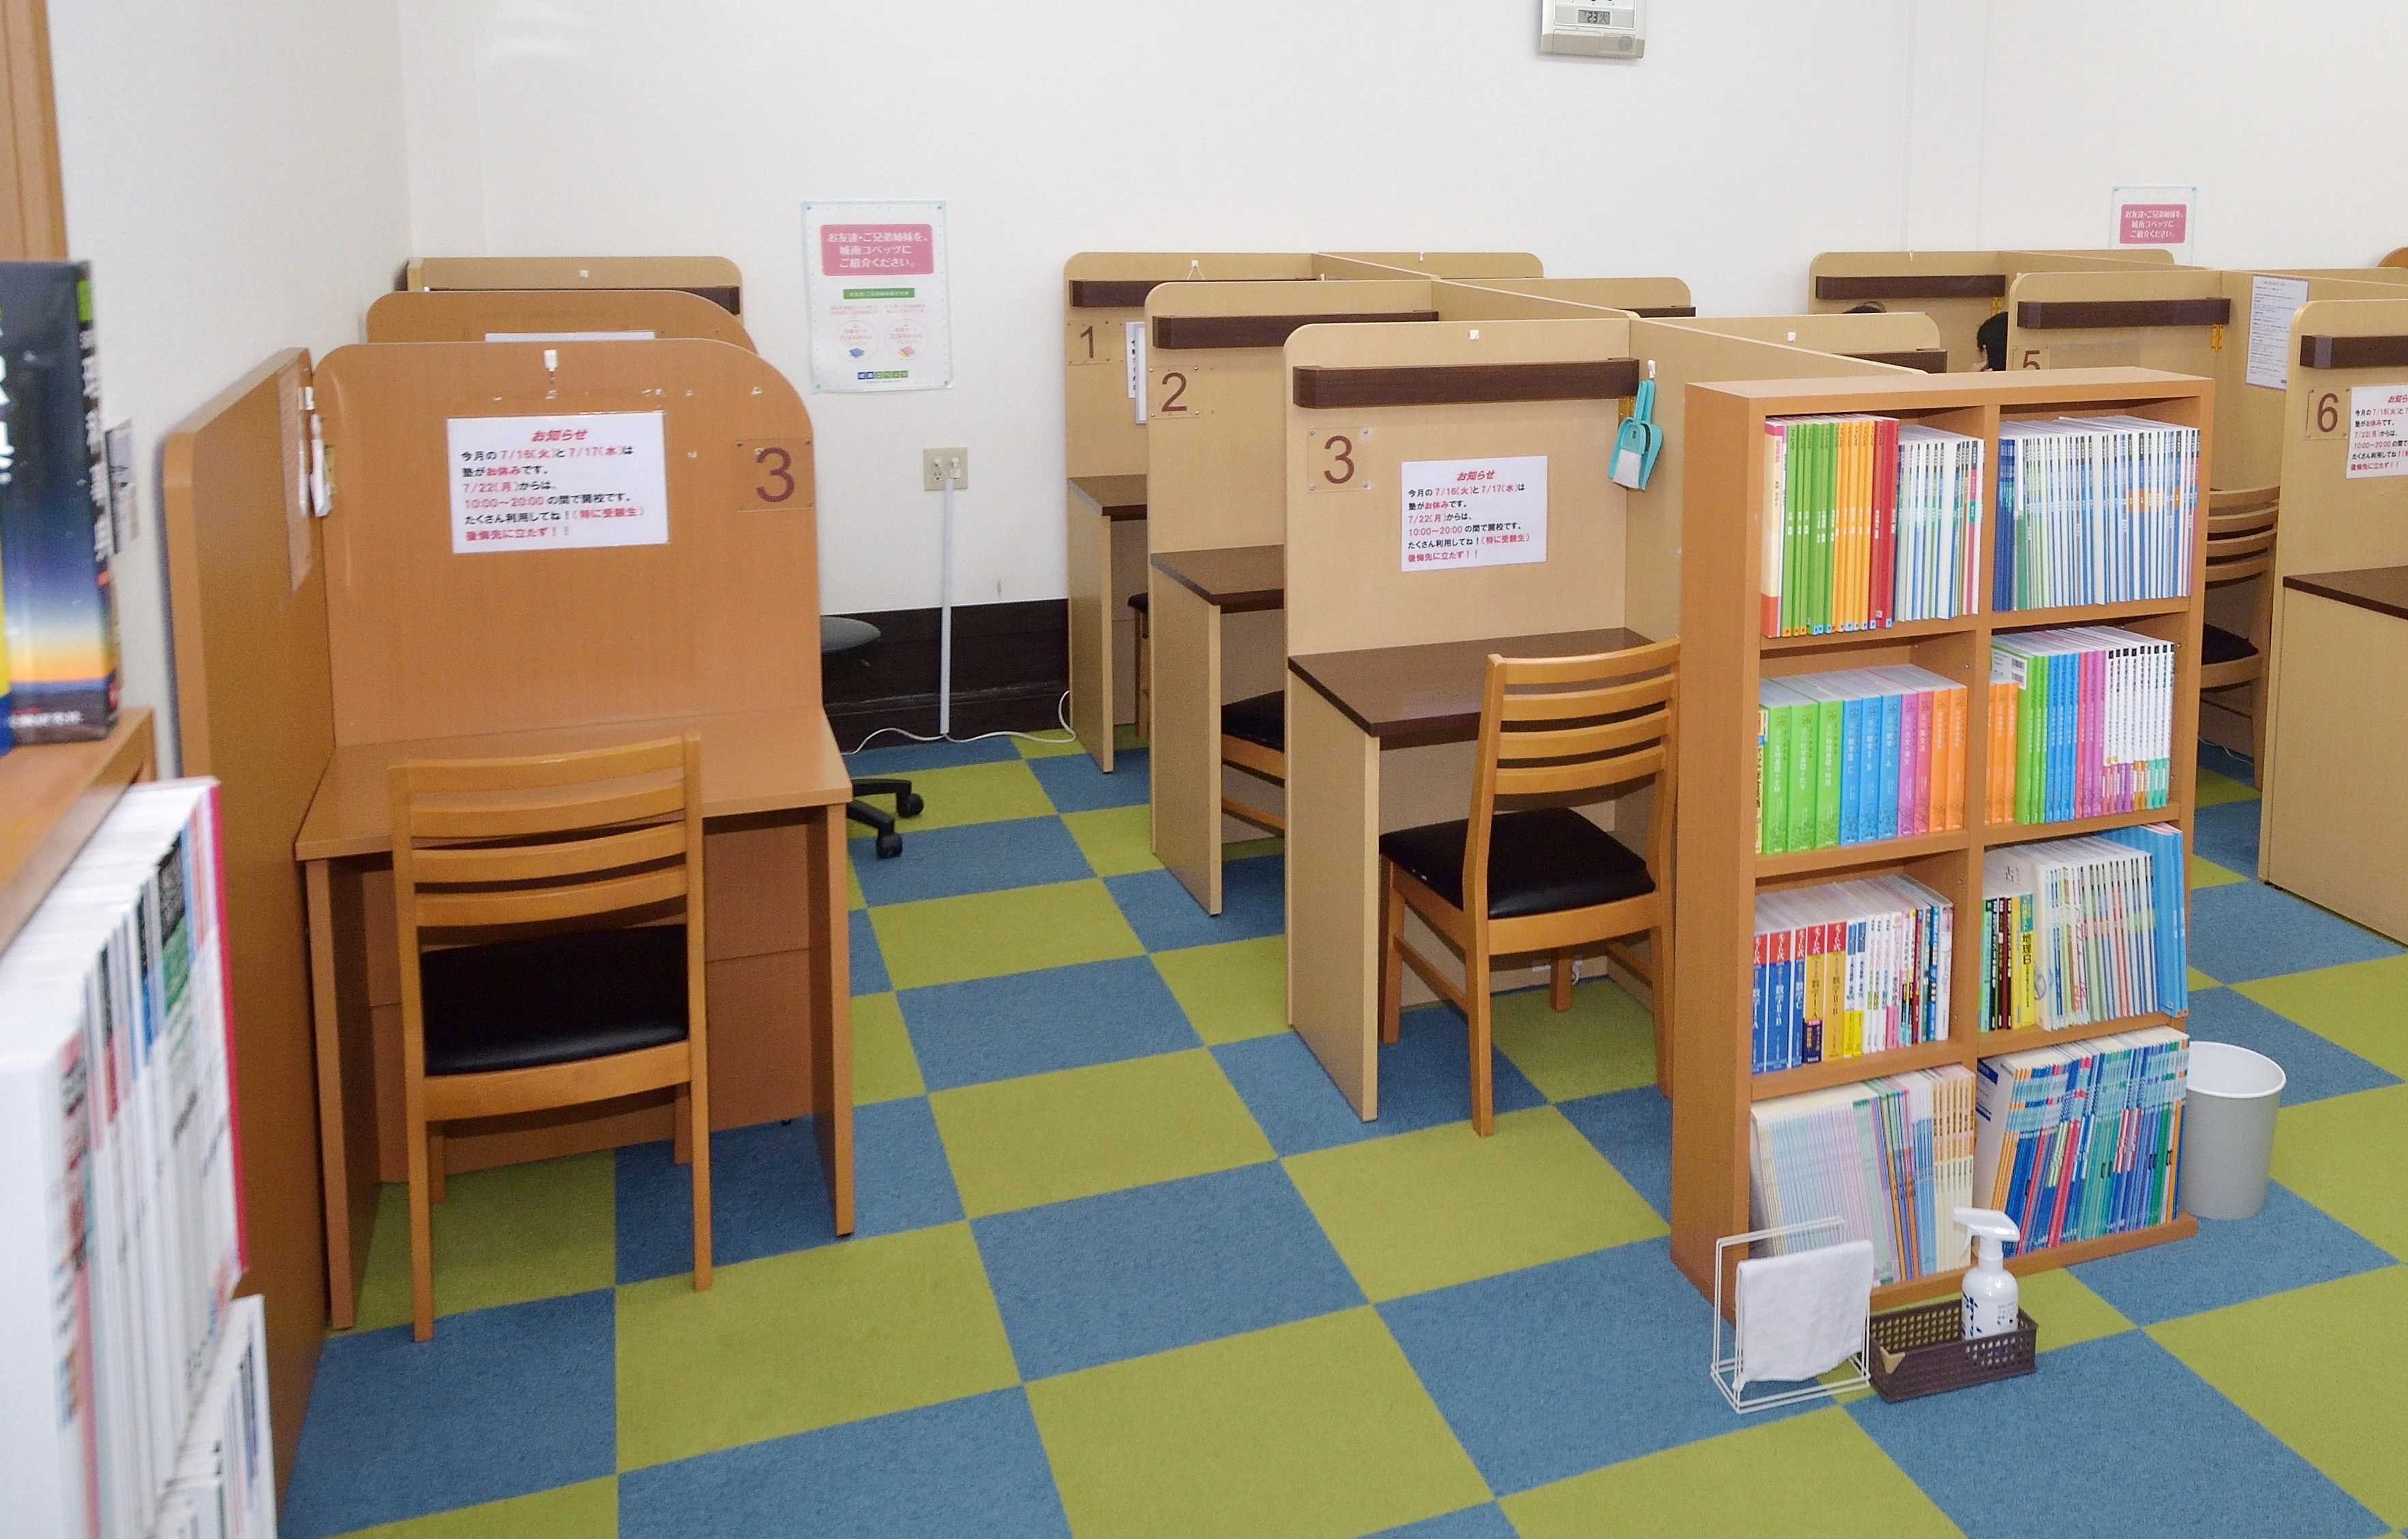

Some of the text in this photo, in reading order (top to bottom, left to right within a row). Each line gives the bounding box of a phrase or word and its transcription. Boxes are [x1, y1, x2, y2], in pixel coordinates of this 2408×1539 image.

[1587, 12, 1598, 23] 23
[839, 258, 915, 269] ご紹介ください。
[1080, 325, 1094, 359] 1
[1161, 372, 1188, 413] 2
[2317, 392, 2339, 433] 6
[755, 447, 795, 503] 3
[1323, 434, 1355, 485] 3
[1457, 469, 1496, 481] お知らせ
